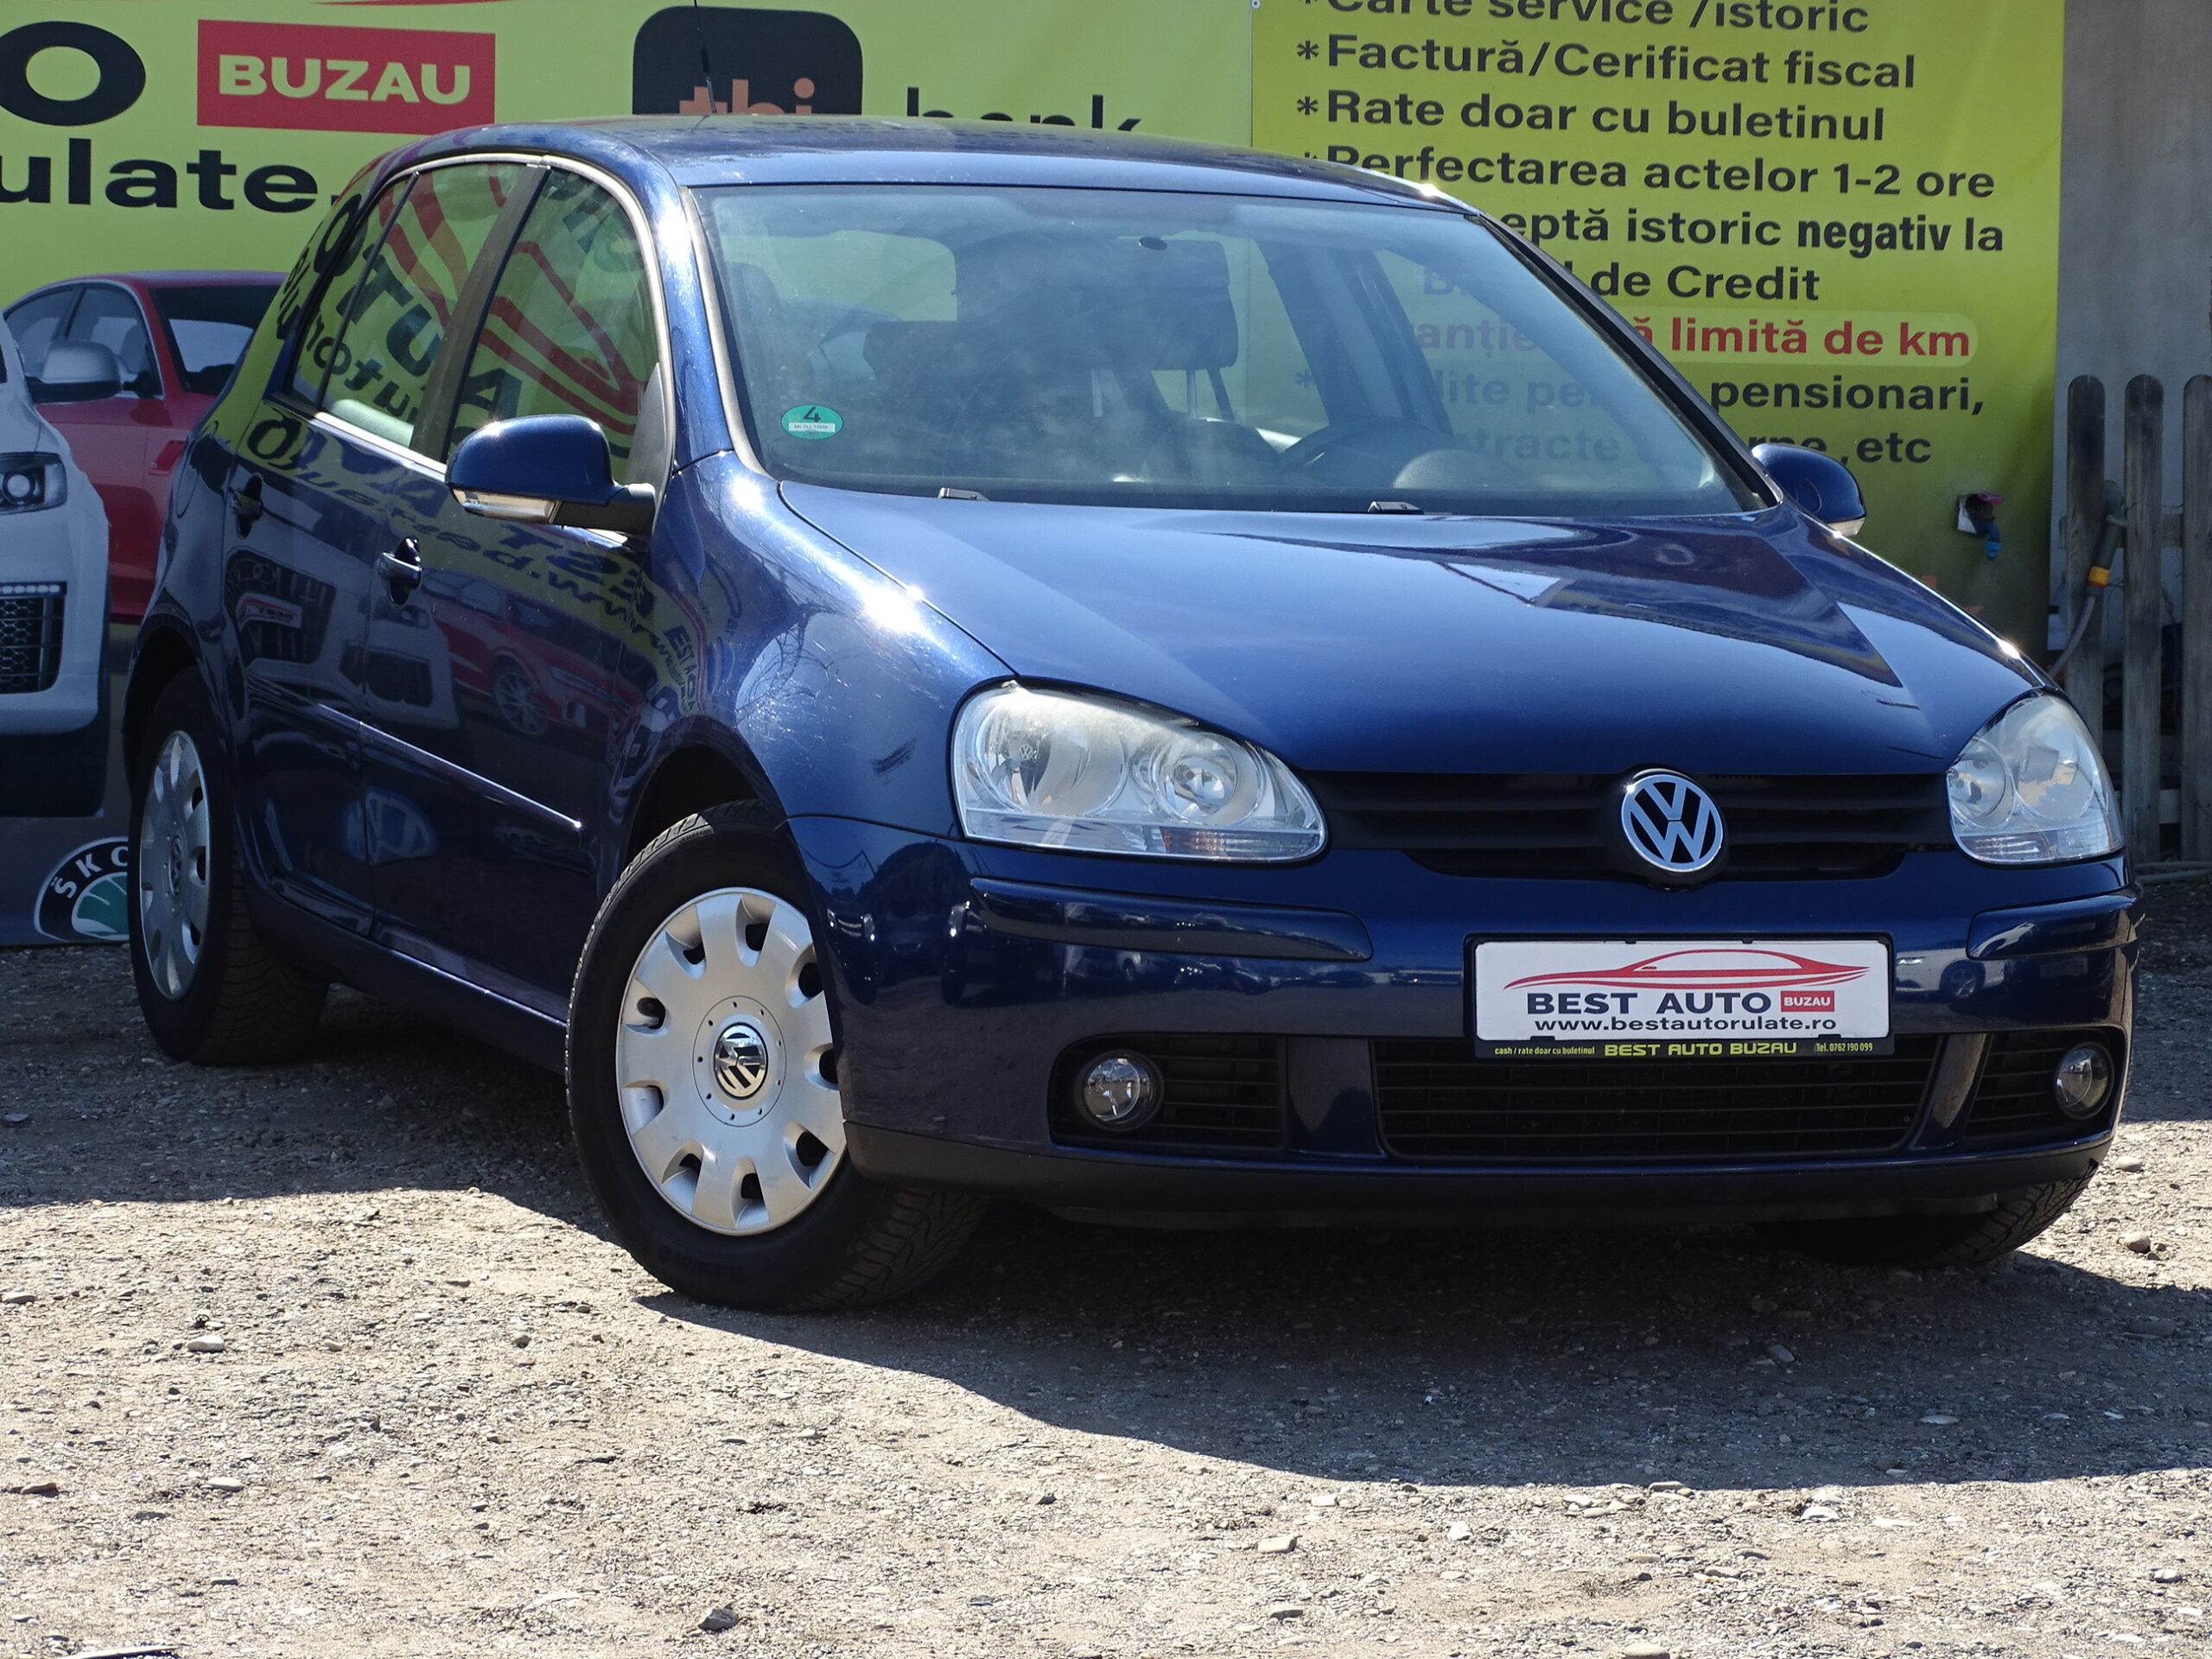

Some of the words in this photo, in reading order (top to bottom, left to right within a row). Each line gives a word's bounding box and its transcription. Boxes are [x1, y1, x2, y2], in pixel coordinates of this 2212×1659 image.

[1489, 0, 1673, 24] service
[219, 54, 471, 105] BUZAU
[1784, 49, 1915, 88] fiscal
[1328, 89, 1444, 126] Rate
[1460, 93, 1577, 130] doar
[1592, 105, 1649, 133] cu
[1668, 100, 1884, 141] buletinul
[1327, 145, 1626, 187] Perfectarea
[1643, 157, 1818, 193] actelor
[1834, 163, 1901, 195] 1-2
[1916, 171, 1994, 198] ore
[1500, 207, 1609, 247] eptă
[1627, 208, 1782, 245] istoric
[1797, 214, 1952, 258] negativ
[1965, 217, 2003, 251] la
[1591, 262, 1651, 296] de
[1667, 264, 1821, 301] Credit
[1672, 317, 1808, 353] limită
[1824, 321, 1884, 355] de
[1900, 321, 1970, 357] km
[1711, 374, 1985, 416] pensionari,
[1527, 992, 1638, 1015] BEST
[1656, 992, 1772, 1014] AUTO
[1783, 996, 1832, 1007] BUZAU
[1535, 1016, 1837, 1031] www.bestautorulate.ro
[1494, 1046, 1513, 1055] cash
[1518, 1046, 1534, 1055] rate
[1534, 1046, 1551, 1055] doar
[1561, 1046, 1595, 1055] buletinul
[1605, 1044, 1661, 1057] BEST
[1668, 1043, 1723, 1056] AUTO
[1730, 1042, 1797, 1055] BUZAU
[1815, 1042, 1829, 1052] Tel.
[1829, 1042, 1847, 1052] 0762
[1847, 1042, 1859, 1052] 190
[1859, 1042, 1873, 1052] 099
